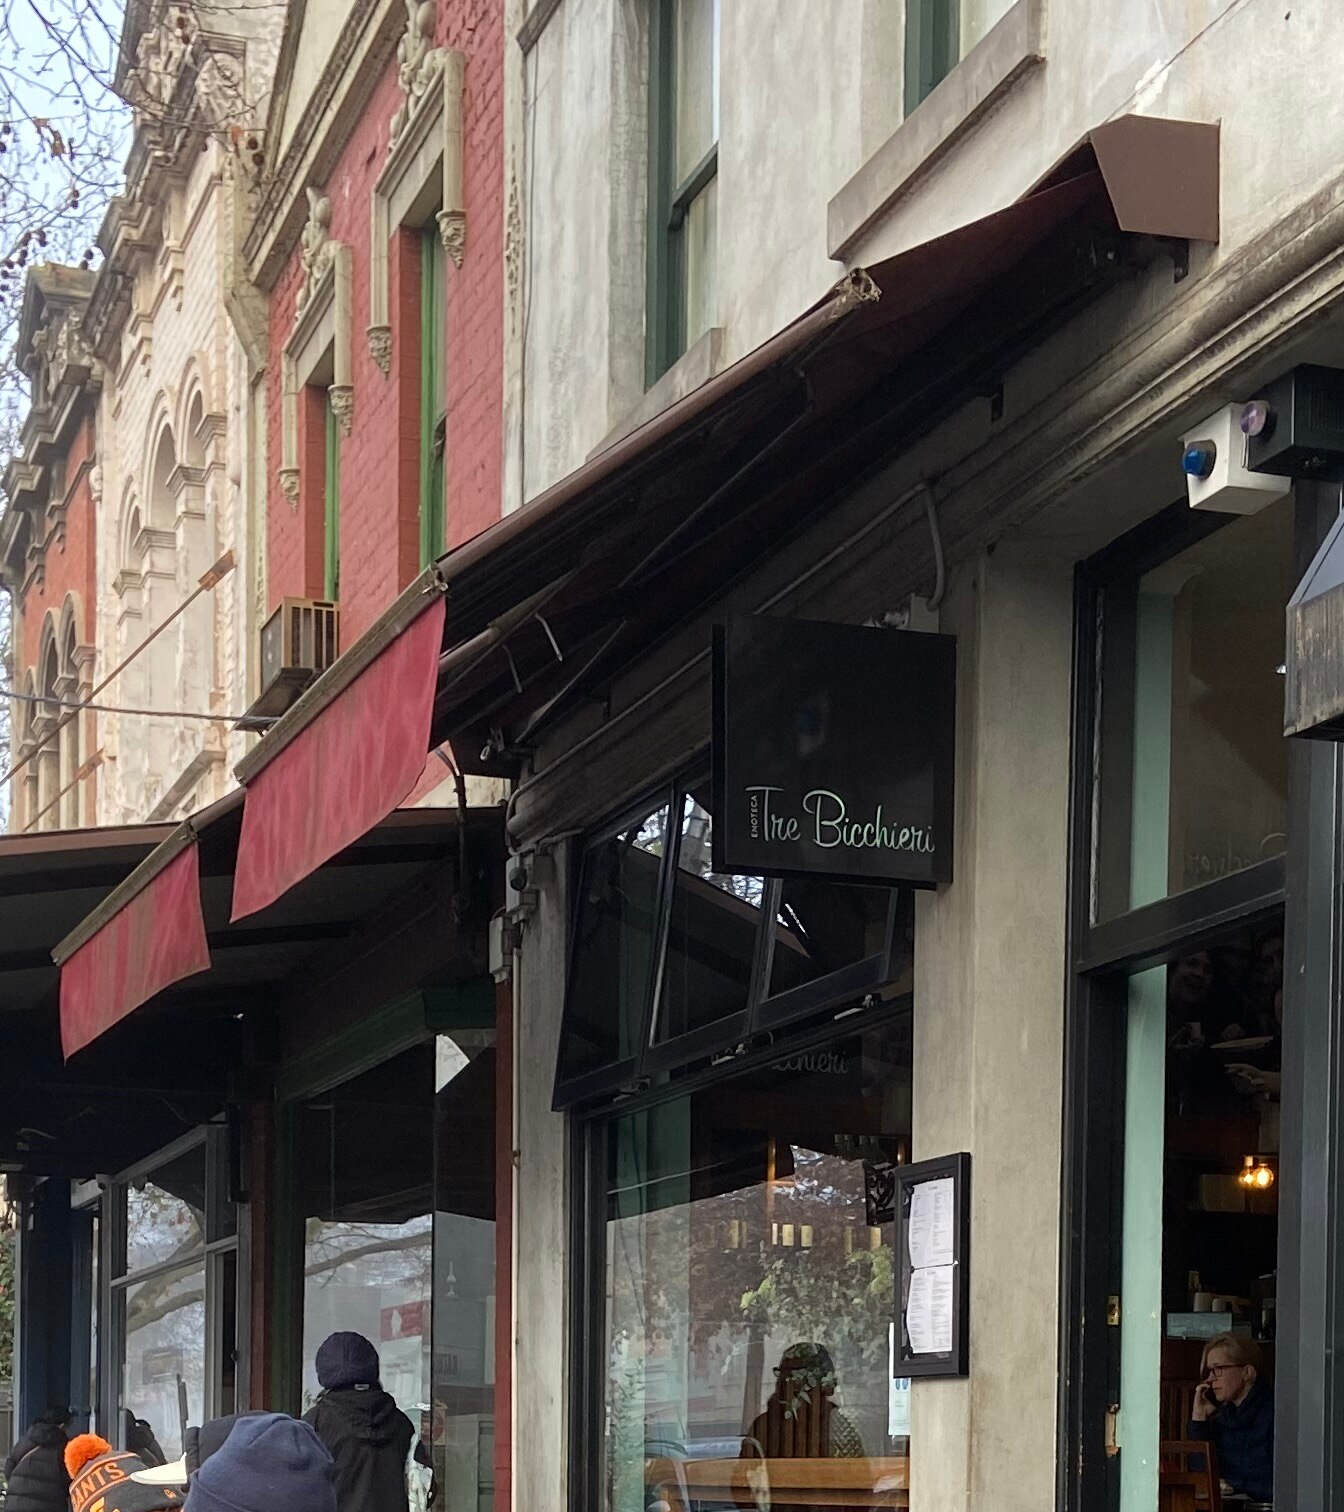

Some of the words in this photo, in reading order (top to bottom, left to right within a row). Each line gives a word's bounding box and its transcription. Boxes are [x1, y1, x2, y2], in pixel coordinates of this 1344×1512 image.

[746, 786, 801, 842] Tre
[803, 789, 935, 853] Bicchieri
[72, 1462, 125, 1512] ANTS
